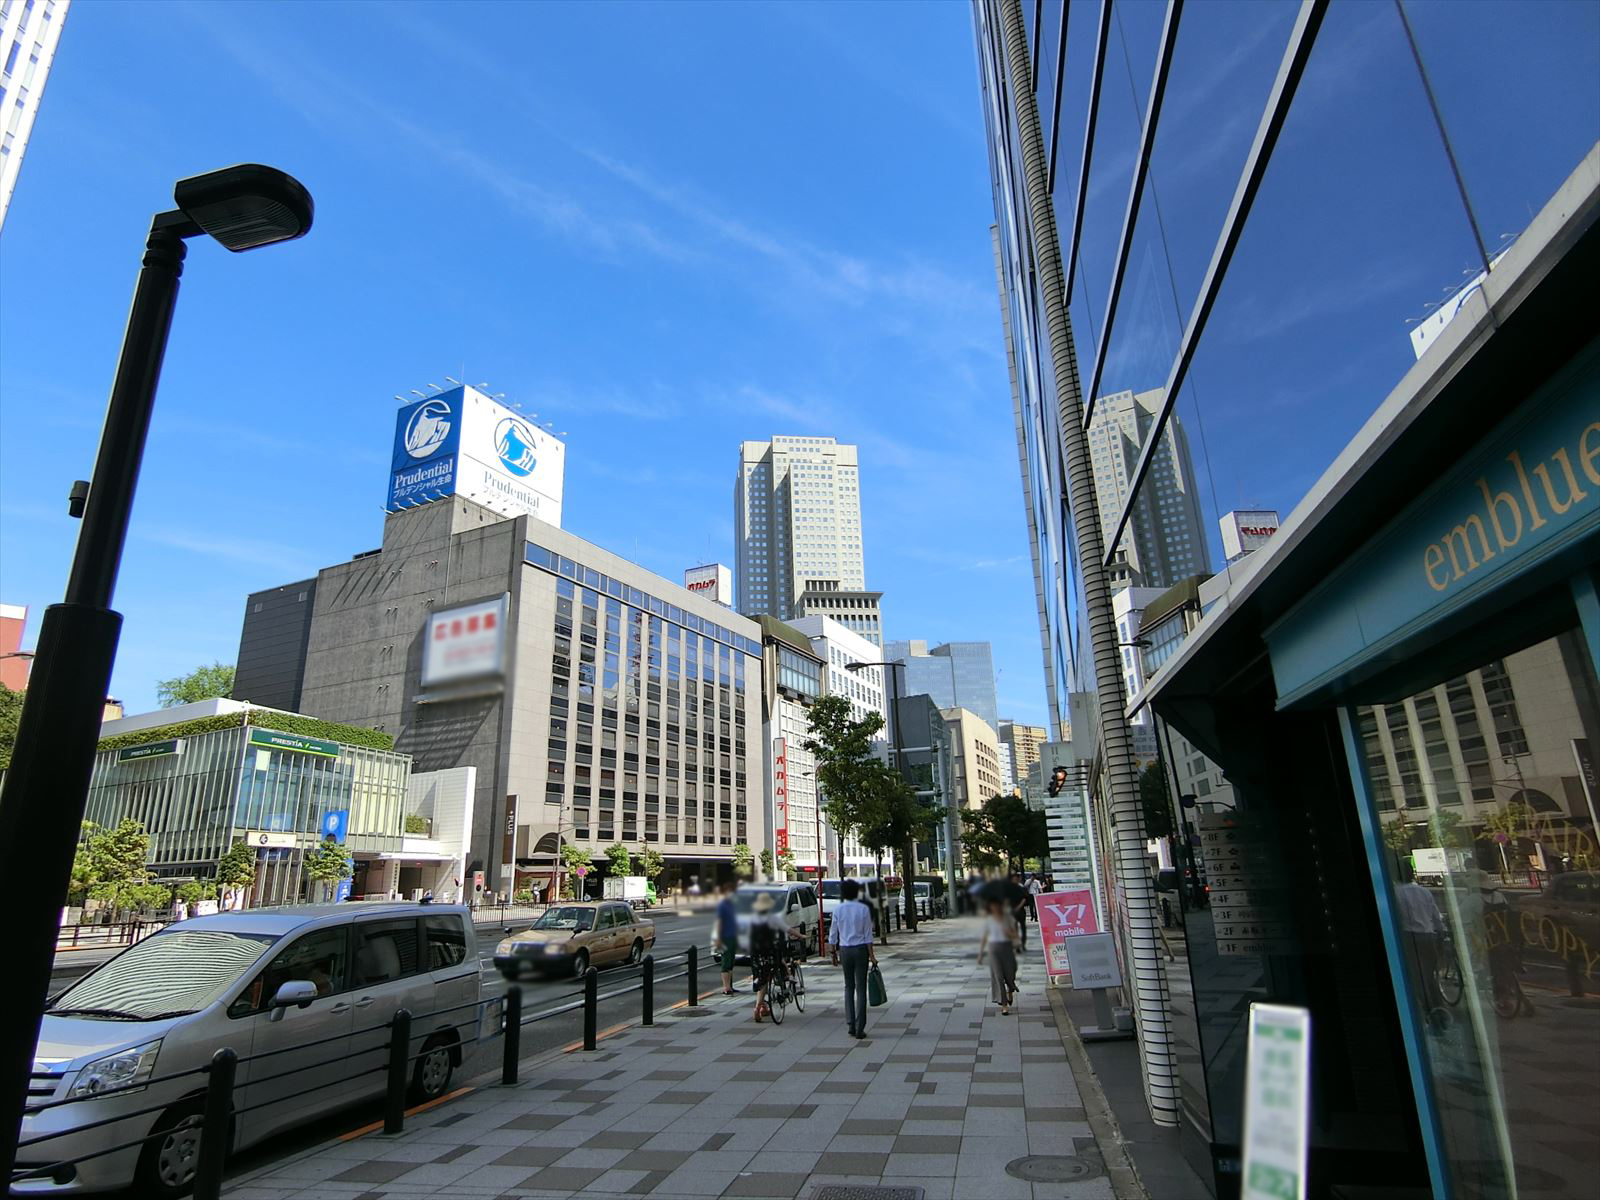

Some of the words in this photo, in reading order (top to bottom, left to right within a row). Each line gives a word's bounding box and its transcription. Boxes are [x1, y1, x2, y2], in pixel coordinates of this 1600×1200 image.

[394, 459, 453, 489] Prudential
[393, 474, 453, 499] プルデンシャル生命
[484, 471, 540, 509] Prudential
[1424, 420, 1600, 592] emblue
[687, 579, 716, 591] オカムラ
[776, 756, 785, 811] オカムラ
[329, 815, 338, 831] P
[1213, 864, 1224, 872] 6F
[1216, 879, 1227, 887] 5F
[1218, 895, 1229, 903] 4F
[1044, 904, 1086, 926] Y!
[1221, 911, 1232, 919] 3F
[1055, 927, 1085, 937] mobile
[1223, 927, 1234, 936] 2F
[1226, 943, 1238, 952] 1F
[1520, 910, 1600, 977] COPY
[1081, 973, 1112, 982] SoftBank
